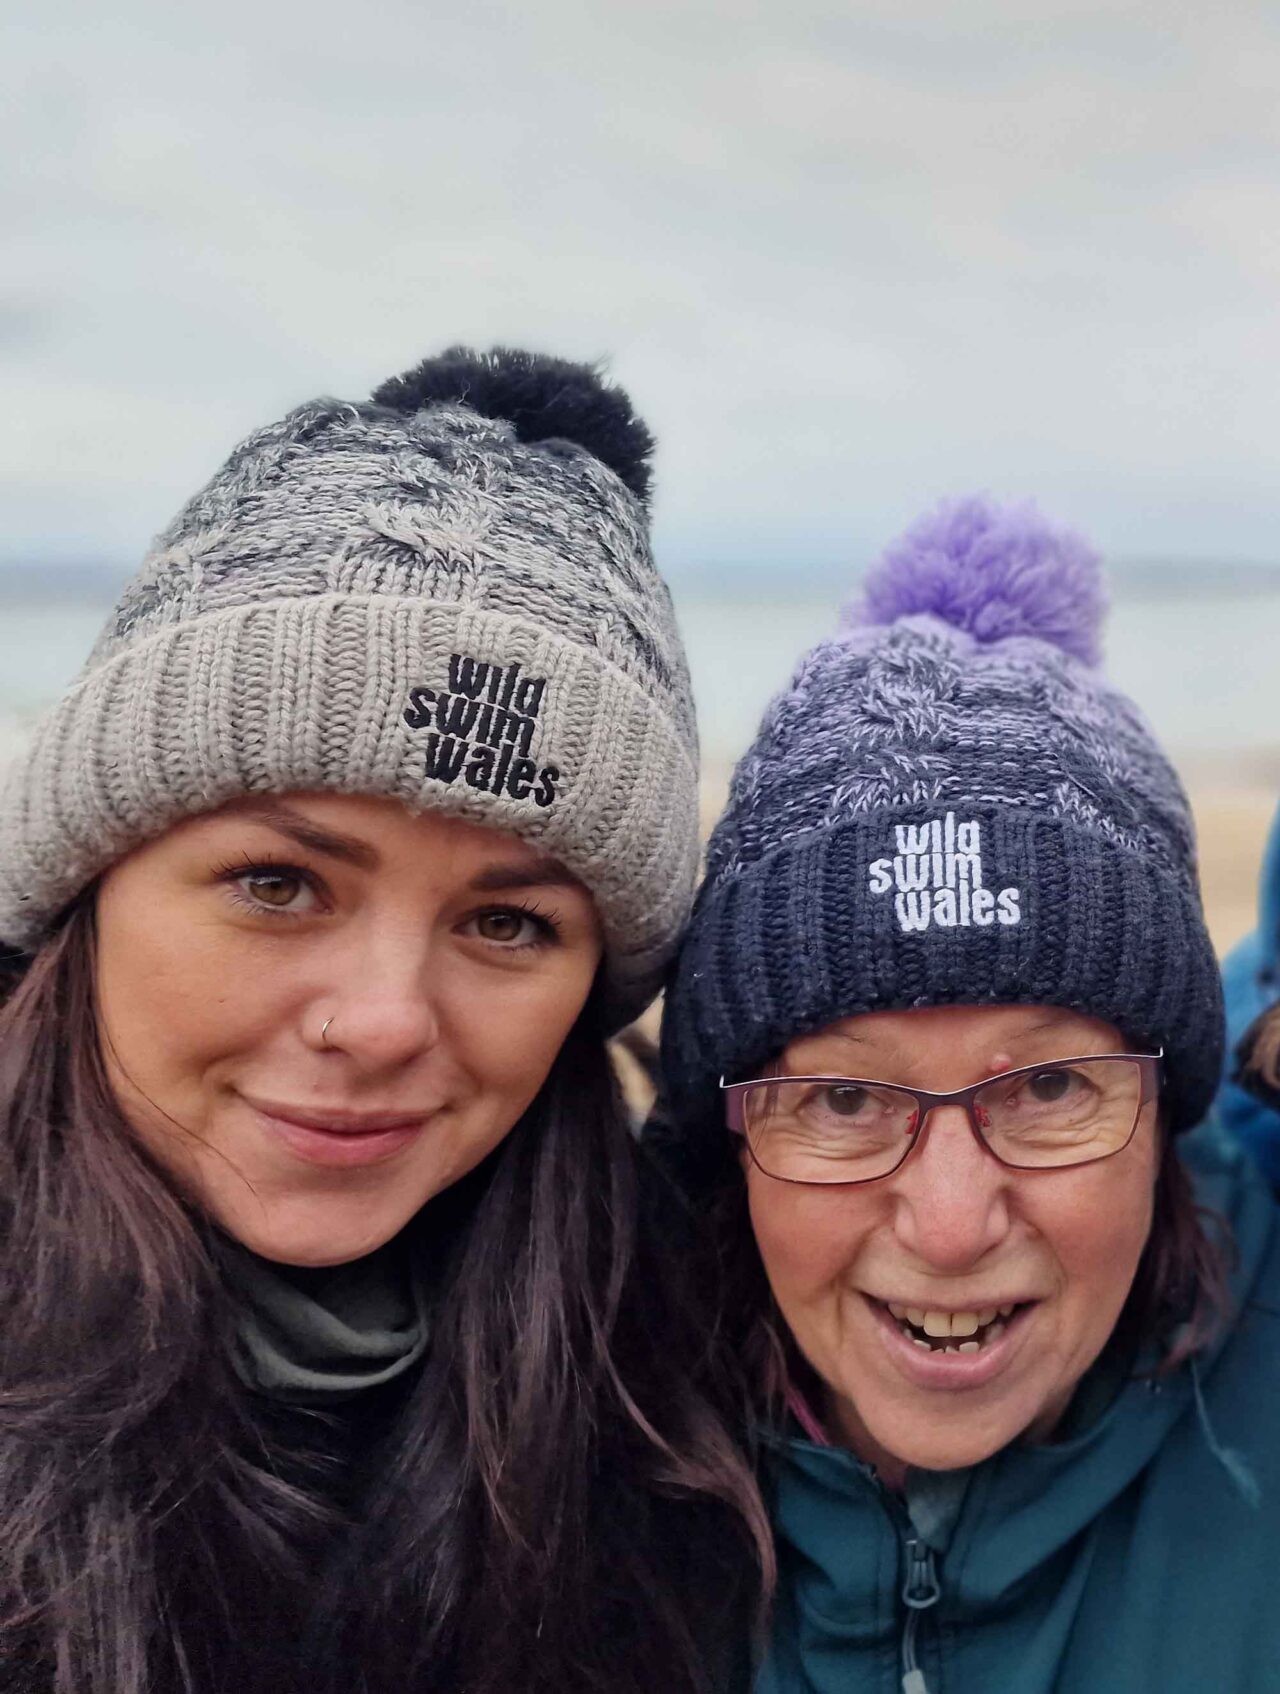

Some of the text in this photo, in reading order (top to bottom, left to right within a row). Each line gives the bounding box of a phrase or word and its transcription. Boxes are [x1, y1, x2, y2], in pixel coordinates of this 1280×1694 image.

[448, 653, 546, 717] wild
[403, 687, 535, 758] swim
[425, 733, 559, 807] wales
[895, 811, 980, 855] wild
[869, 852, 982, 894] swim
[894, 879, 1021, 932] wales
